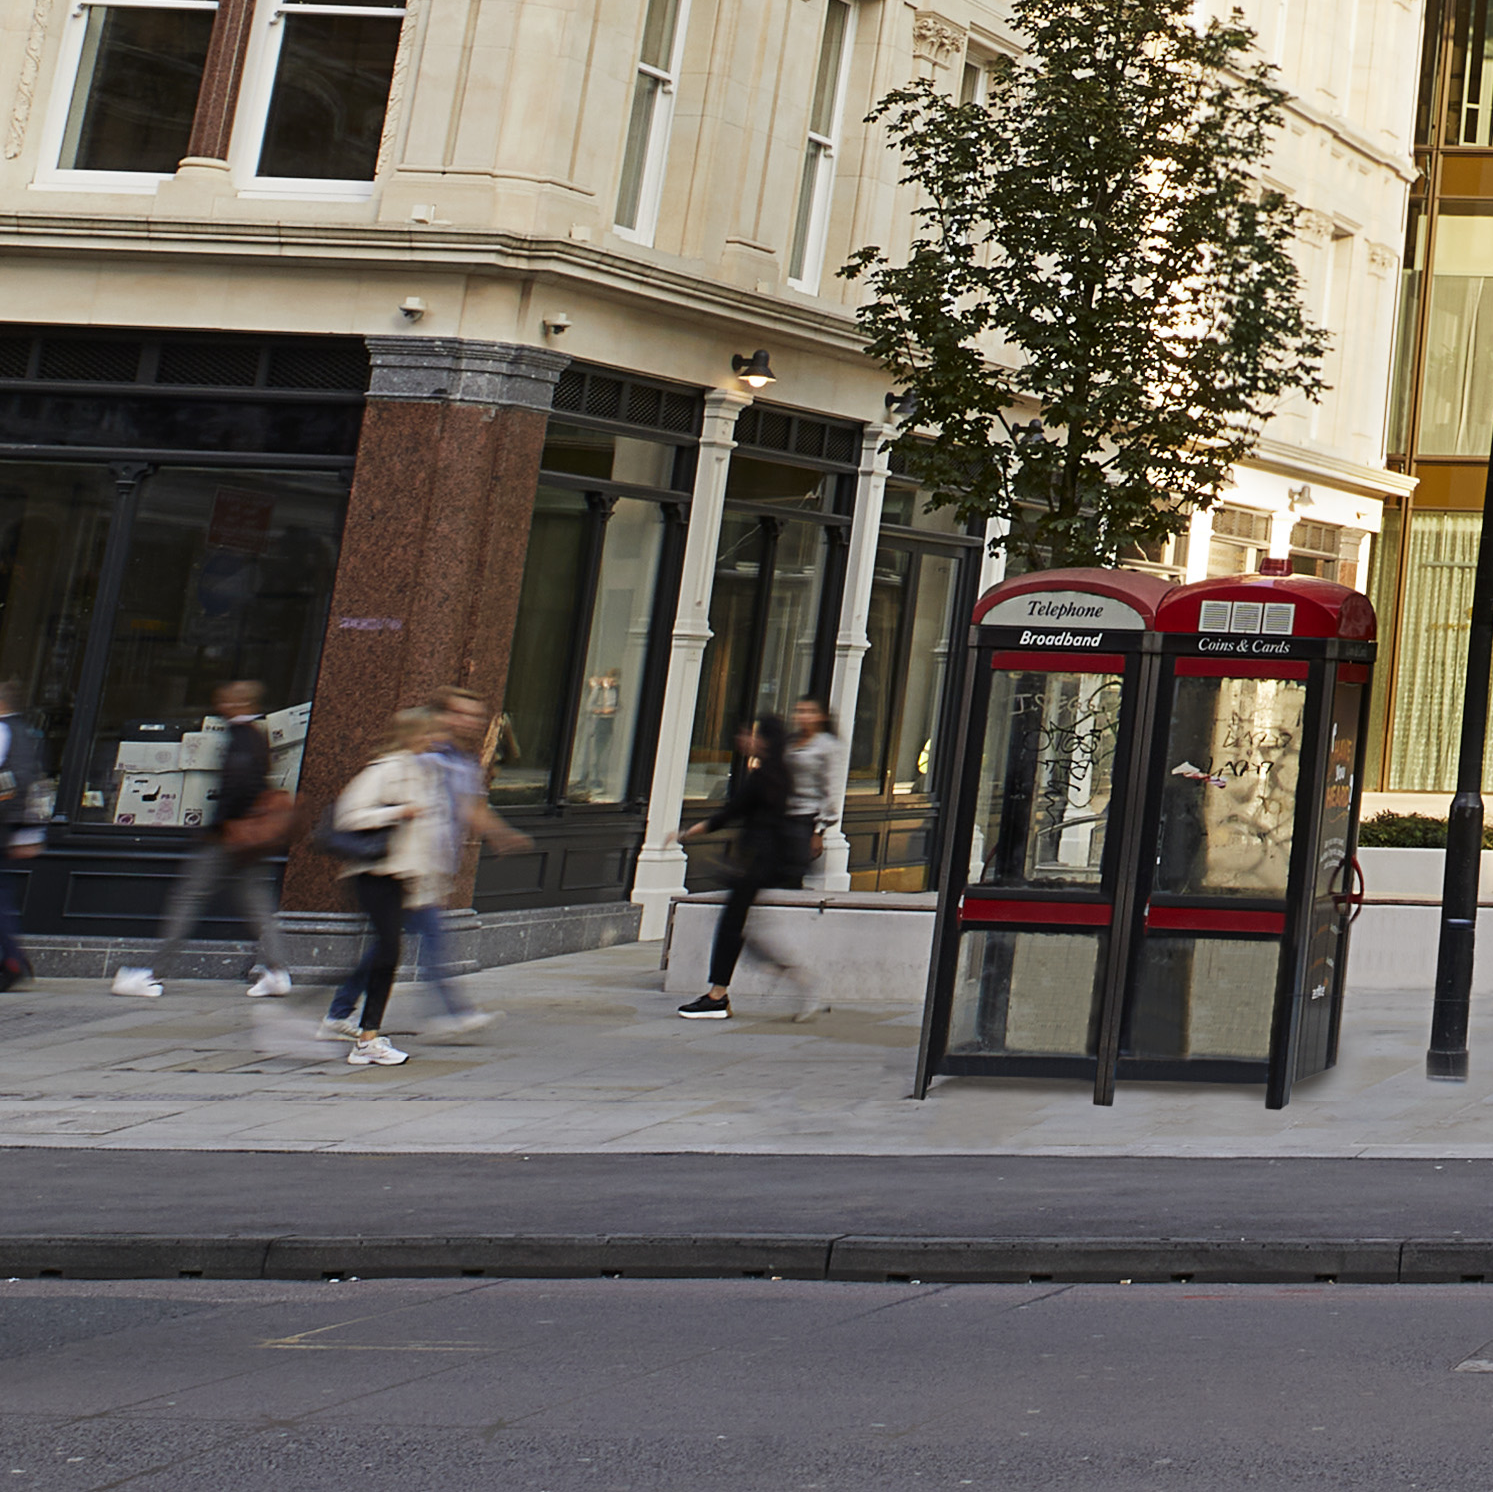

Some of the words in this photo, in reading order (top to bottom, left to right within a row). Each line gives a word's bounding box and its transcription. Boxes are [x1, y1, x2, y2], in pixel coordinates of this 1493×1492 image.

[1027, 601, 1103, 619] Telephone
[1020, 630, 1103, 646] Broadband
[1198, 637, 1235, 652] Coins
[1236, 639, 1248, 653] &
[1251, 639, 1290, 654] Cards
